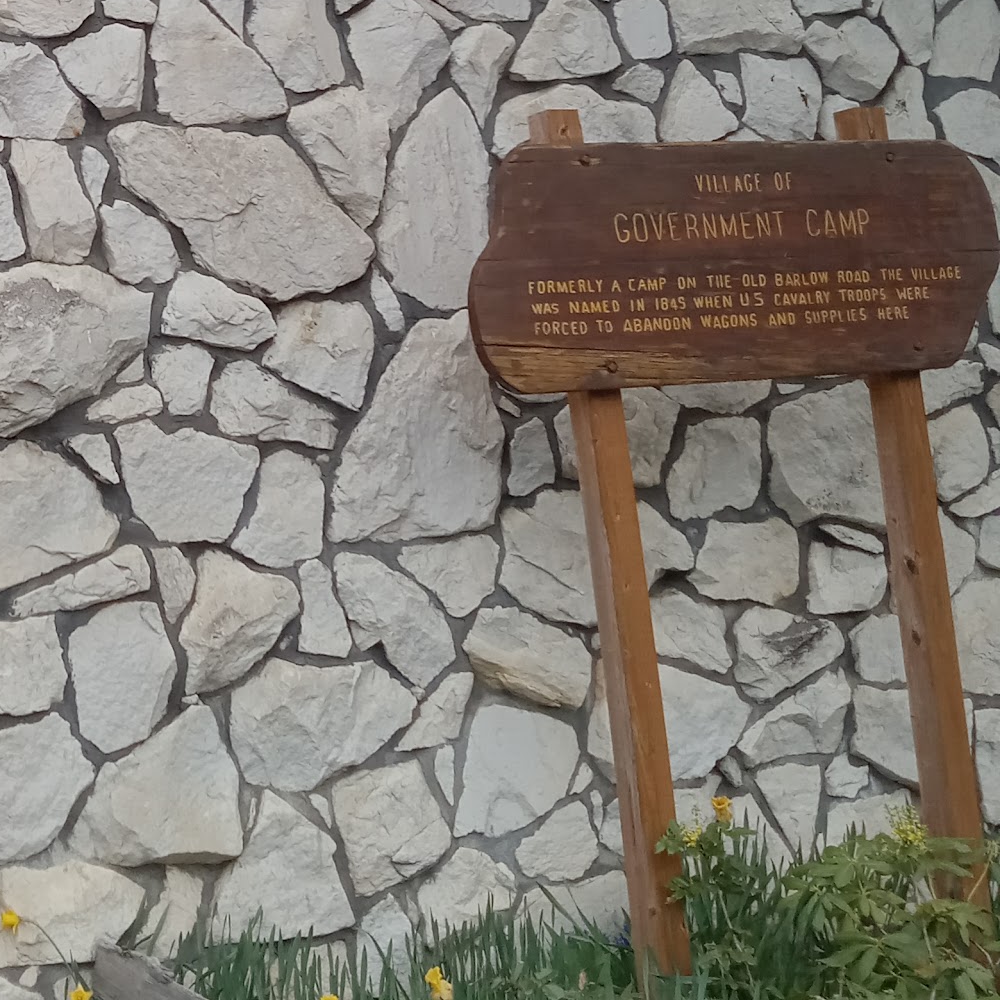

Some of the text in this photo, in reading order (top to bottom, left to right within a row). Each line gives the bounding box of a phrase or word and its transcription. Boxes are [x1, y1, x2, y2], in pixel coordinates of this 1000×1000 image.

[694, 171, 792, 193] VILLAGE OF
[613, 208, 871, 243] GOVERNMENT CAMP
[528, 266, 962, 295] FORMERLY A CAMP ON THE OLD BARLOW ROAD THE VILLAGE
[531, 303, 560, 315] WAS
[568, 299, 621, 314] NAMED
[630, 298, 645, 312] IN
[693, 294, 733, 309] WHEN
[774, 290, 831, 306] CAVALRY
[838, 288, 886, 302] TROOPS
[896, 286, 931, 301] WERE
[534, 306, 910, 336] FORCED TO ABANDON WAGONS AND SUPPLIES HERE
